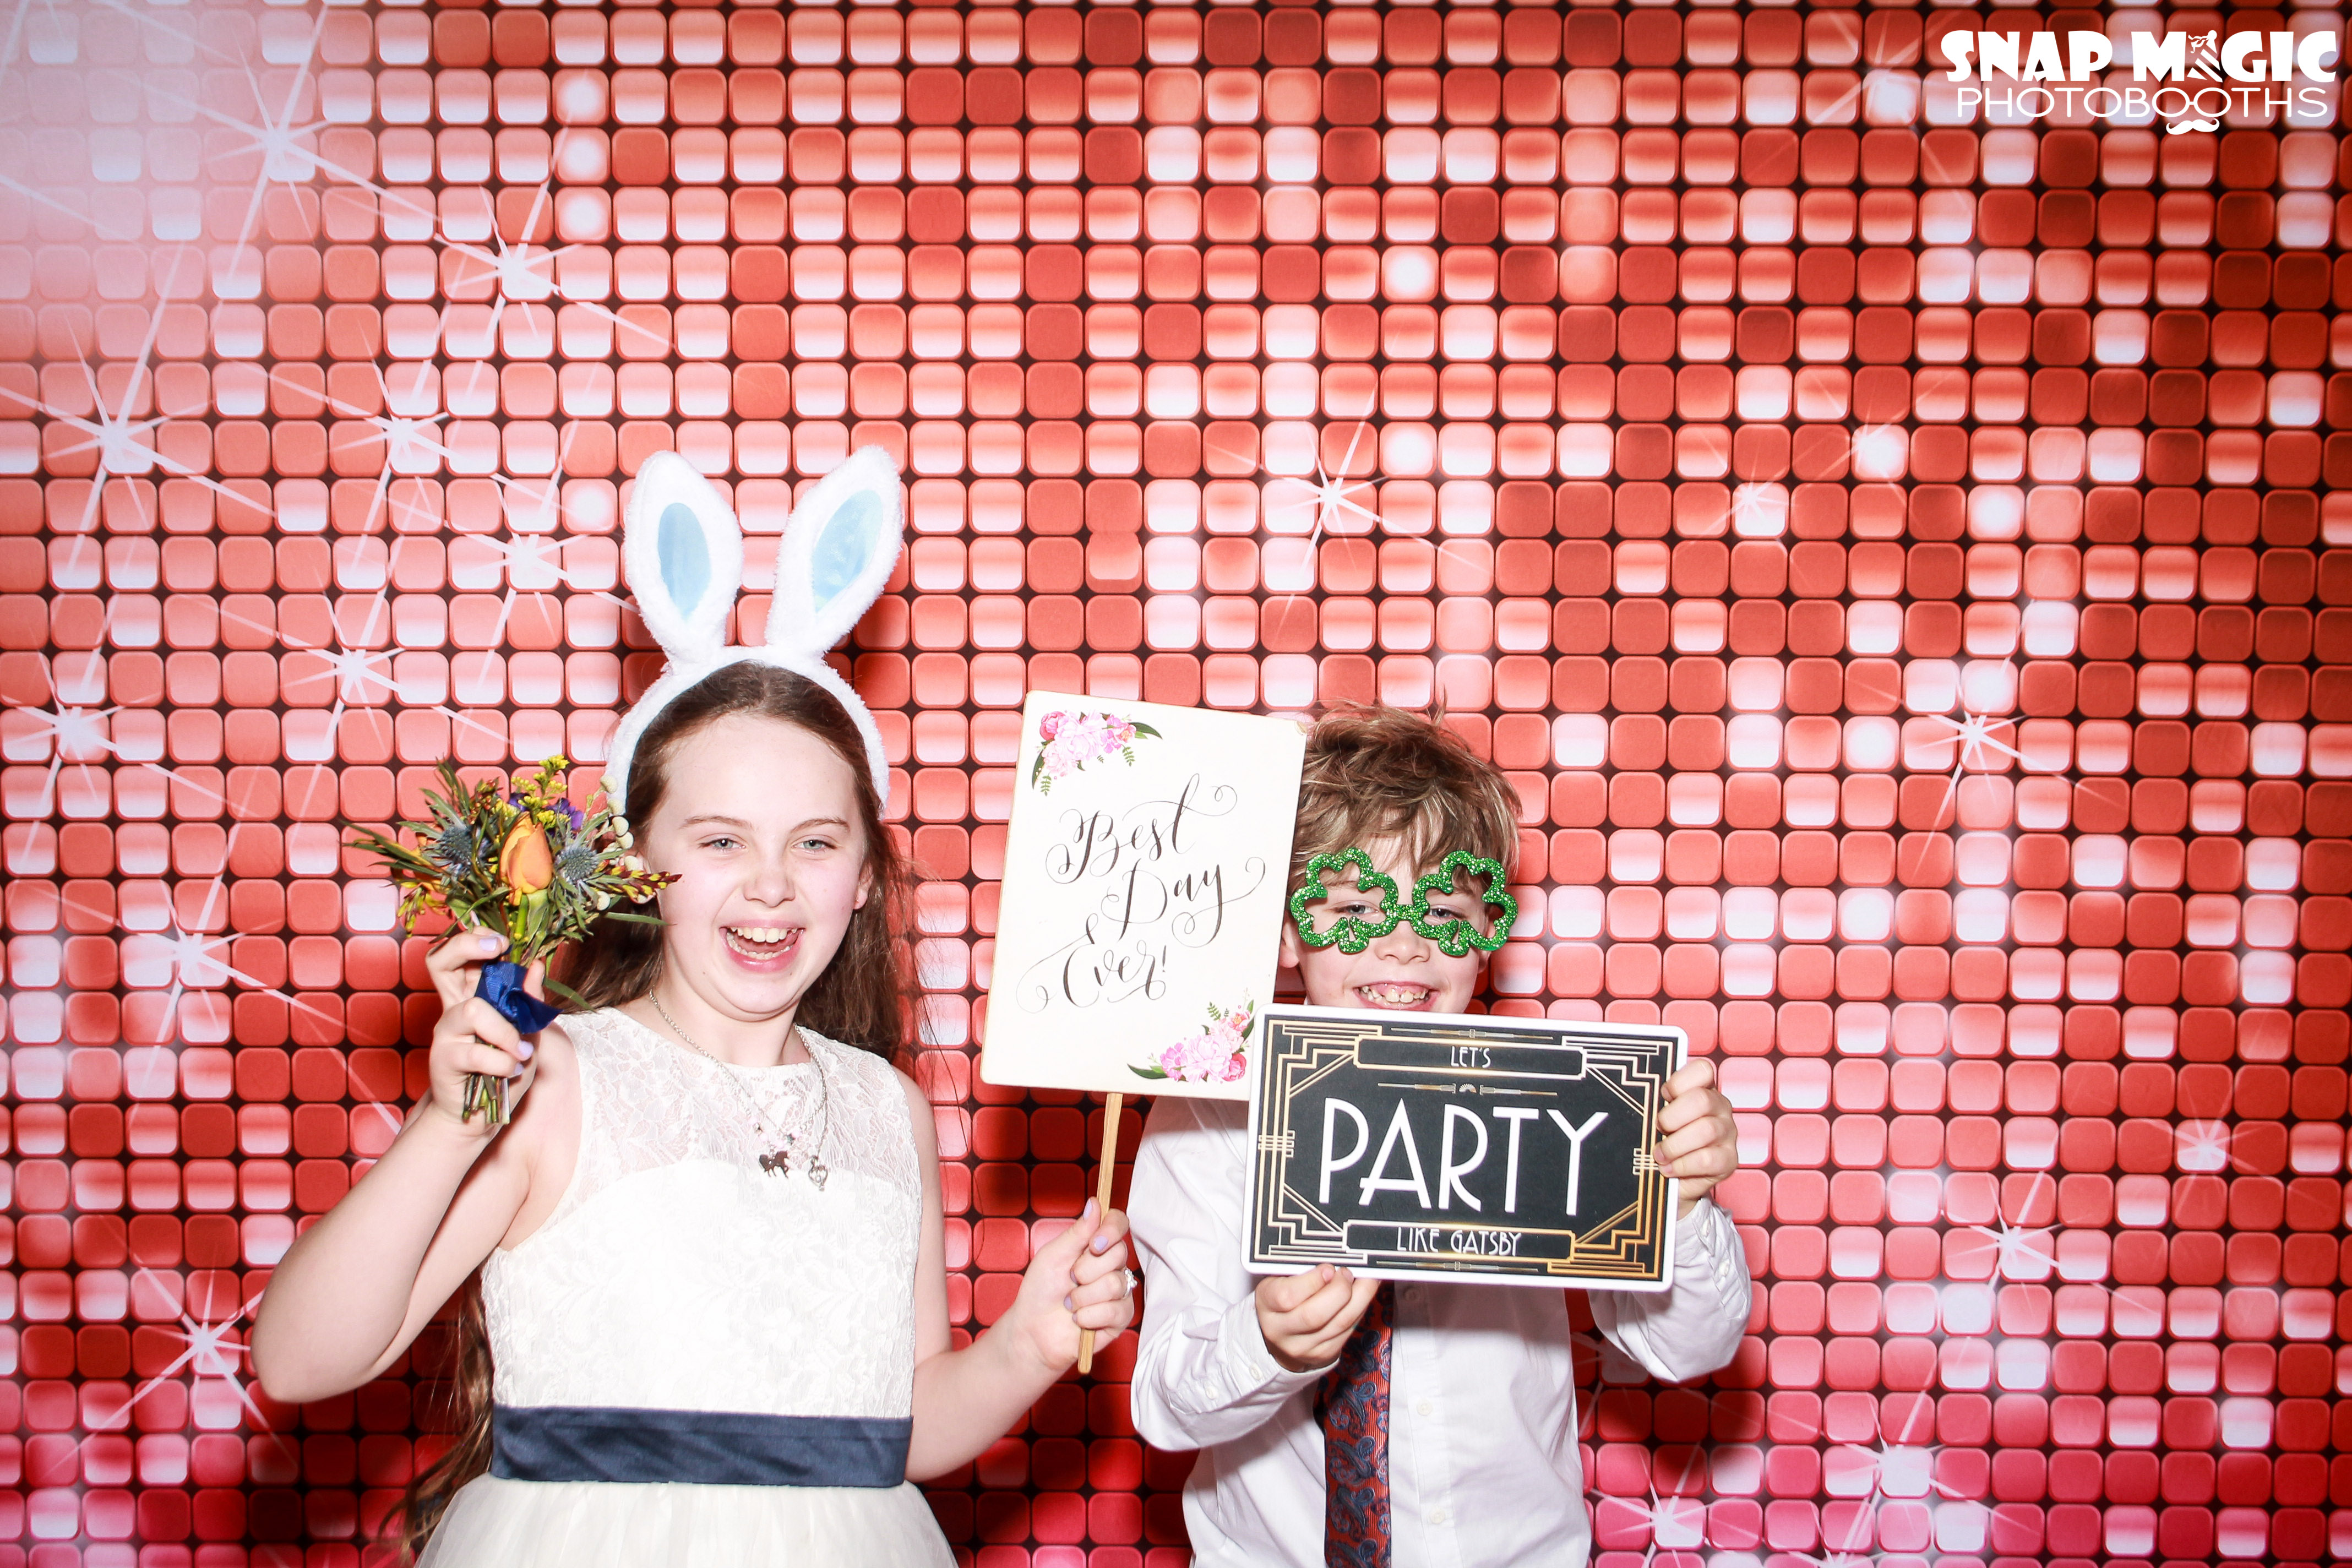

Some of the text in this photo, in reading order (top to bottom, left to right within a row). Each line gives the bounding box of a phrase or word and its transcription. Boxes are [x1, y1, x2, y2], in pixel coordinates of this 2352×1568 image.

[1046, 773, 1238, 884] Best
[1101, 856, 1266, 948] Day
[1016, 913, 1167, 1014] Ever!
[1451, 1045, 1491, 1068] LET'S
[1319, 1097, 1609, 1216] PARTY
[1397, 1227, 1522, 1256] LIKE GATSBY
